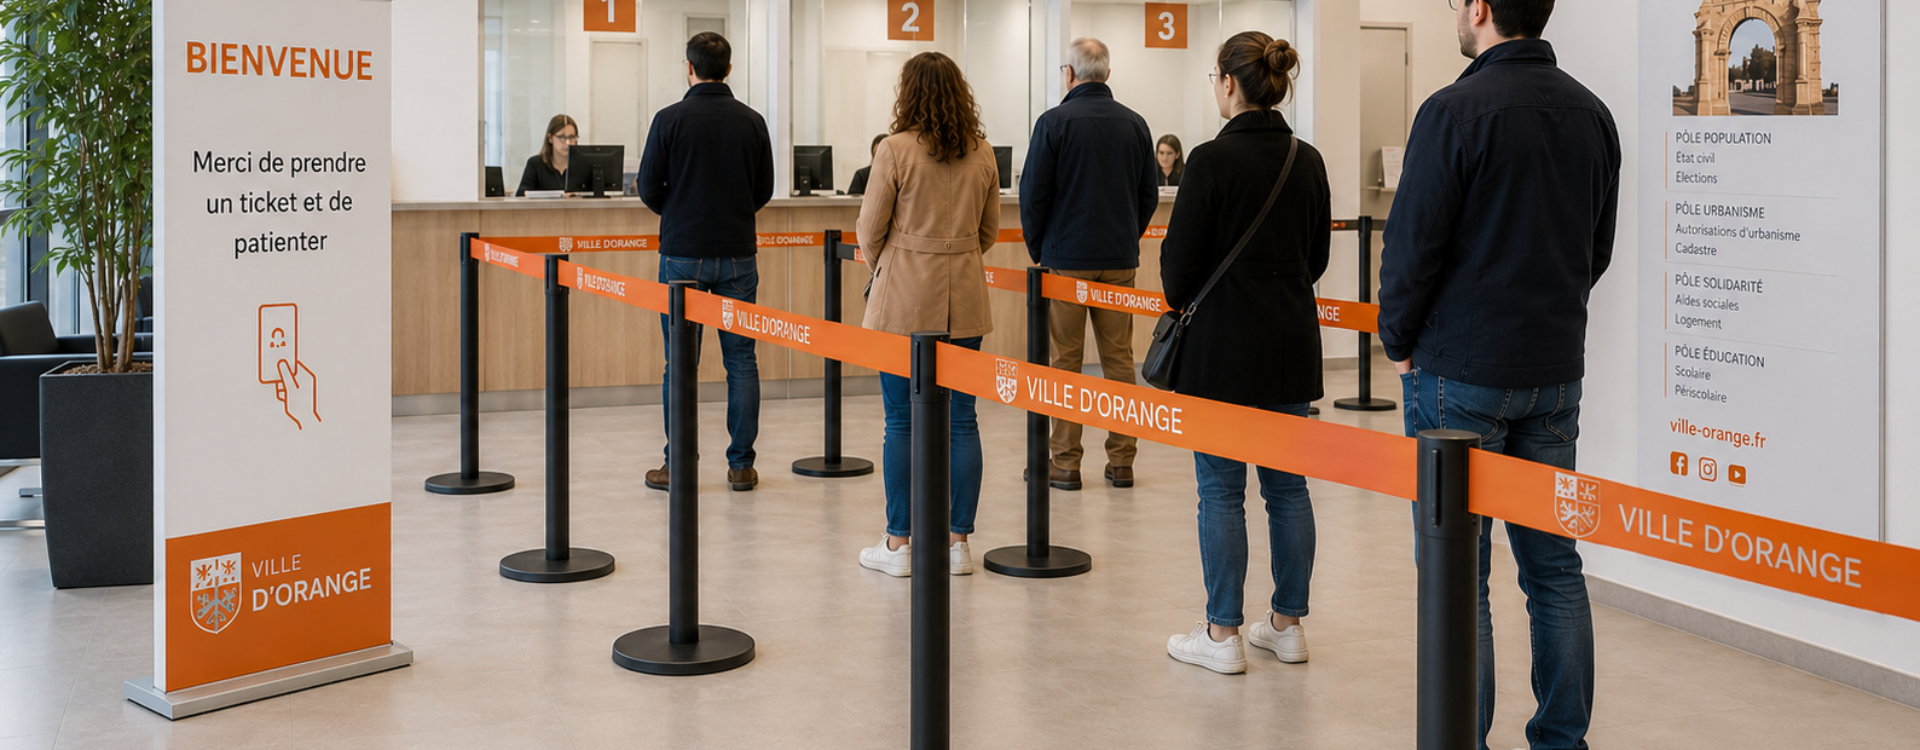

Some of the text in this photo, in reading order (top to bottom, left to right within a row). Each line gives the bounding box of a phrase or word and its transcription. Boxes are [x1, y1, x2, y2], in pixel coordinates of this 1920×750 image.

[901, 1, 920, 32] 2
[1157, 11, 1176, 41] 3
[186, 41, 373, 81] BIENVENUE
[1675, 129, 1772, 145] PÔLE POPULATION
[193, 151, 367, 178] Merci de prendre
[1696, 152, 1715, 164] civil
[206, 190, 353, 214] un ticket et de
[1675, 200, 1765, 219] PÔLE URBANISME
[1675, 223, 1801, 242] Autorisations d'urbanisme
[234, 231, 328, 260] patienter
[1675, 242, 1718, 256] Cadastre
[1675, 271, 1764, 294] PÔLE SOLIDARITÉ
[1090, 288, 1114, 305] VILLE
[1703, 297, 1739, 311] sociales
[736, 309, 760, 333] VILLE
[1675, 313, 1723, 330] Logement
[1675, 343, 1765, 368] PÔLE ÉDUCATION
[1675, 365, 1712, 381] Scolaire
[1026, 375, 1184, 435] VILLE D'ORANGE
[1675, 384, 1728, 403] Périscolaire
[1670, 417, 1767, 449] ville-orange.fr
[1619, 503, 1863, 589] VILLE D'ORANGE
[251, 553, 302, 578] VILLE
[252, 567, 372, 612] D'ORANGE
